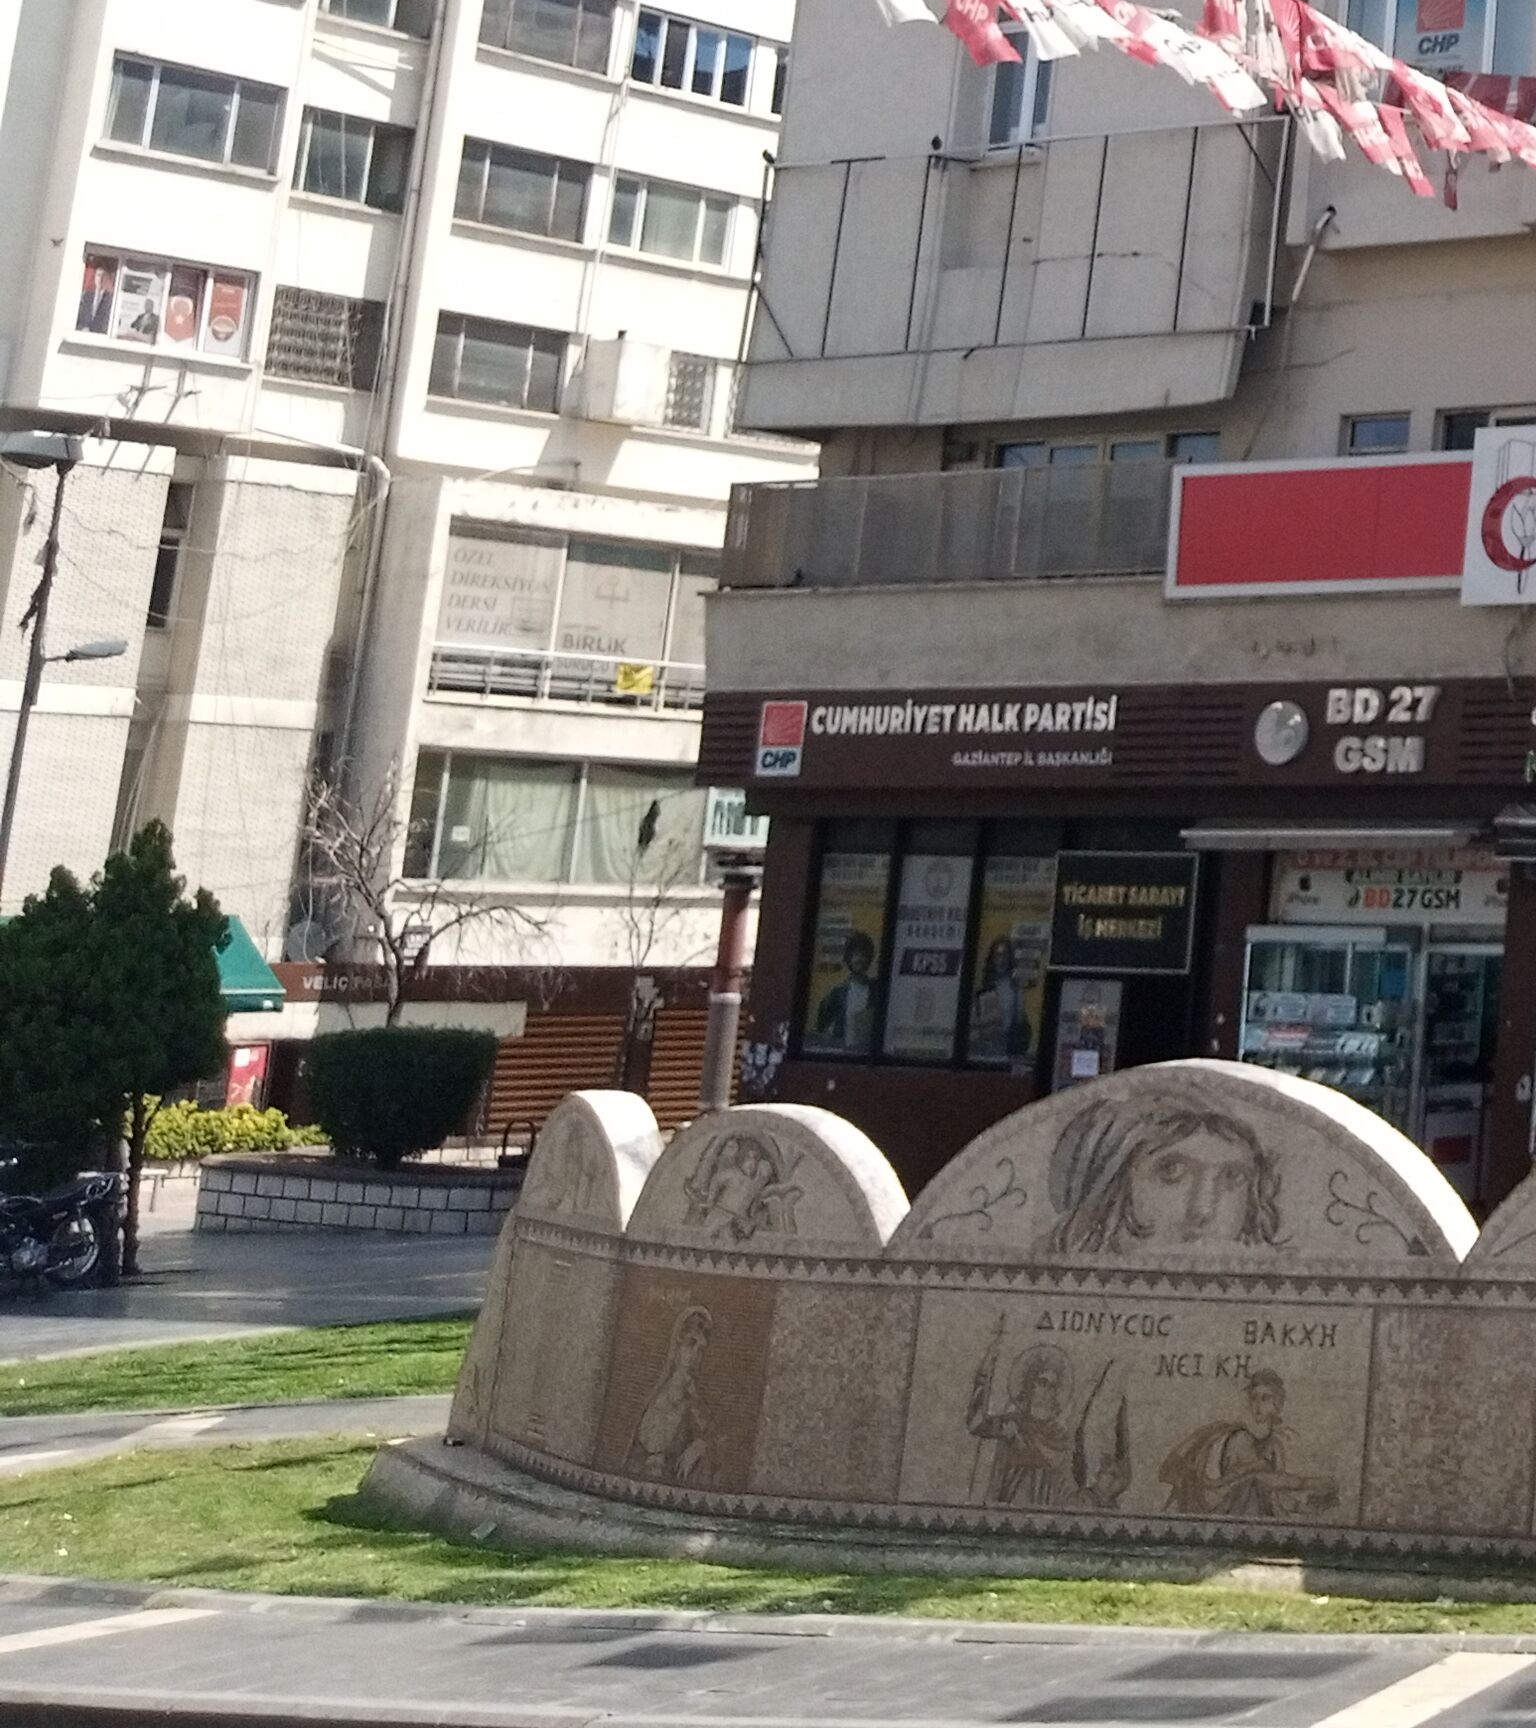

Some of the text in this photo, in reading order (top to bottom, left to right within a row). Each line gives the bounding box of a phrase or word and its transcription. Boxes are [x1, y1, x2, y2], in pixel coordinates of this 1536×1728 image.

[1418, 33, 1460, 55] CHP
[811, 694, 1118, 736] CUMHURİYET HALK PARTİSİ
[1326, 686, 1441, 726] BD 27
[761, 749, 797, 770] CHP
[1334, 736, 1427, 774] GSM
